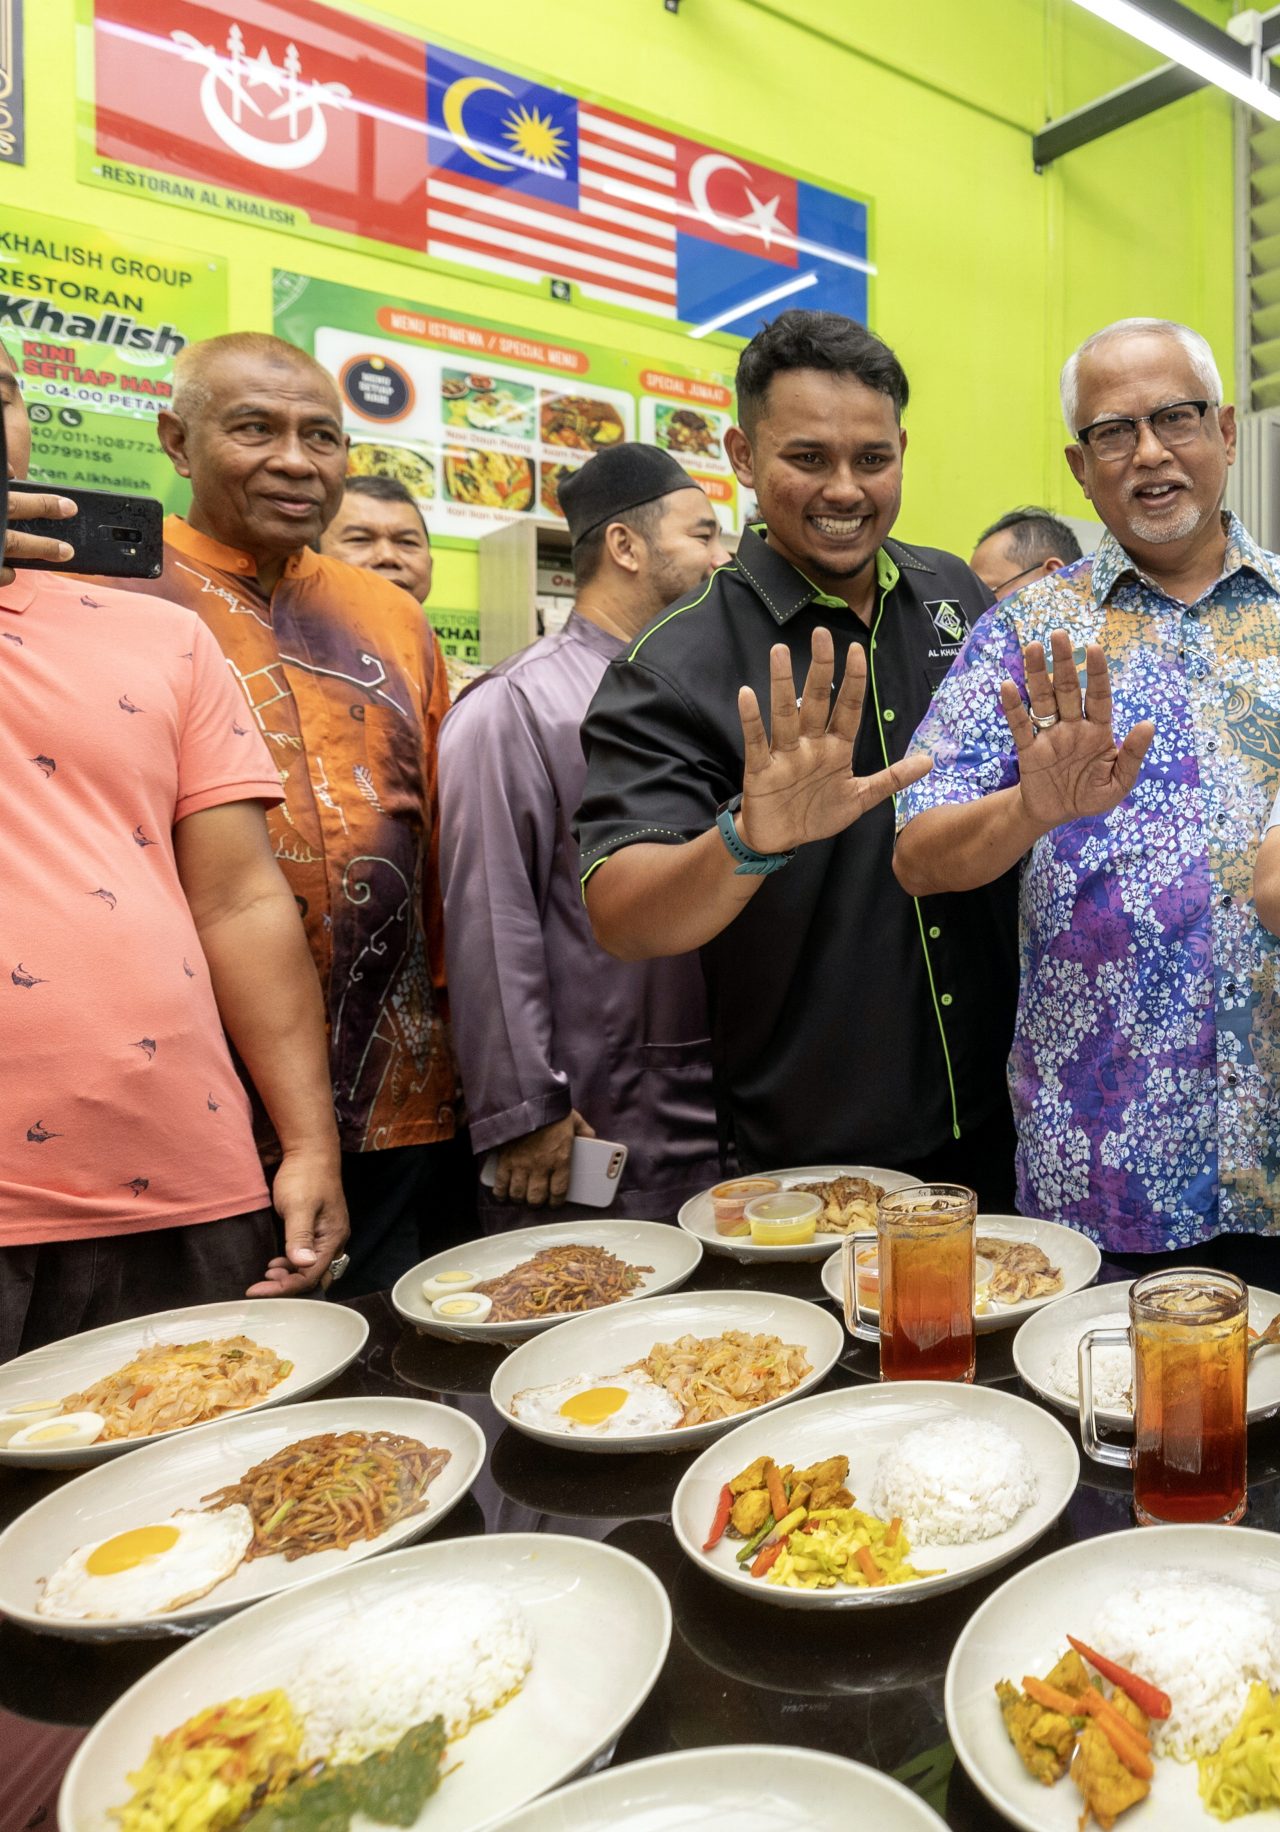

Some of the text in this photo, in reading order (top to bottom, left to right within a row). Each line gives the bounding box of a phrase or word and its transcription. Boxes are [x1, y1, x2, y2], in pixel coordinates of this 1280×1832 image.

[101, 165, 296, 227] RESTORAN AL KHALISH
[0, 232, 192, 289] KHALISH GROUP
[0, 267, 144, 313] RESTORAN
[0, 294, 186, 356] Khalish
[390, 313, 426, 333] MENU
[428, 325, 484, 349] ISTIMEWA
[499, 338, 544, 361] SPECIAL
[547, 349, 578, 369] MENU
[23, 340, 75, 364] KINI
[23, 359, 116, 387] SETIAP
[121, 375, 173, 398] HAR
[45, 383, 103, 404] 04.00
[109, 394, 172, 413] PETAN
[646, 373, 725, 400] SPECIAL JUMAAT
[74, 471, 151, 490] Alkhalish
[928, 649, 939, 658] AL
